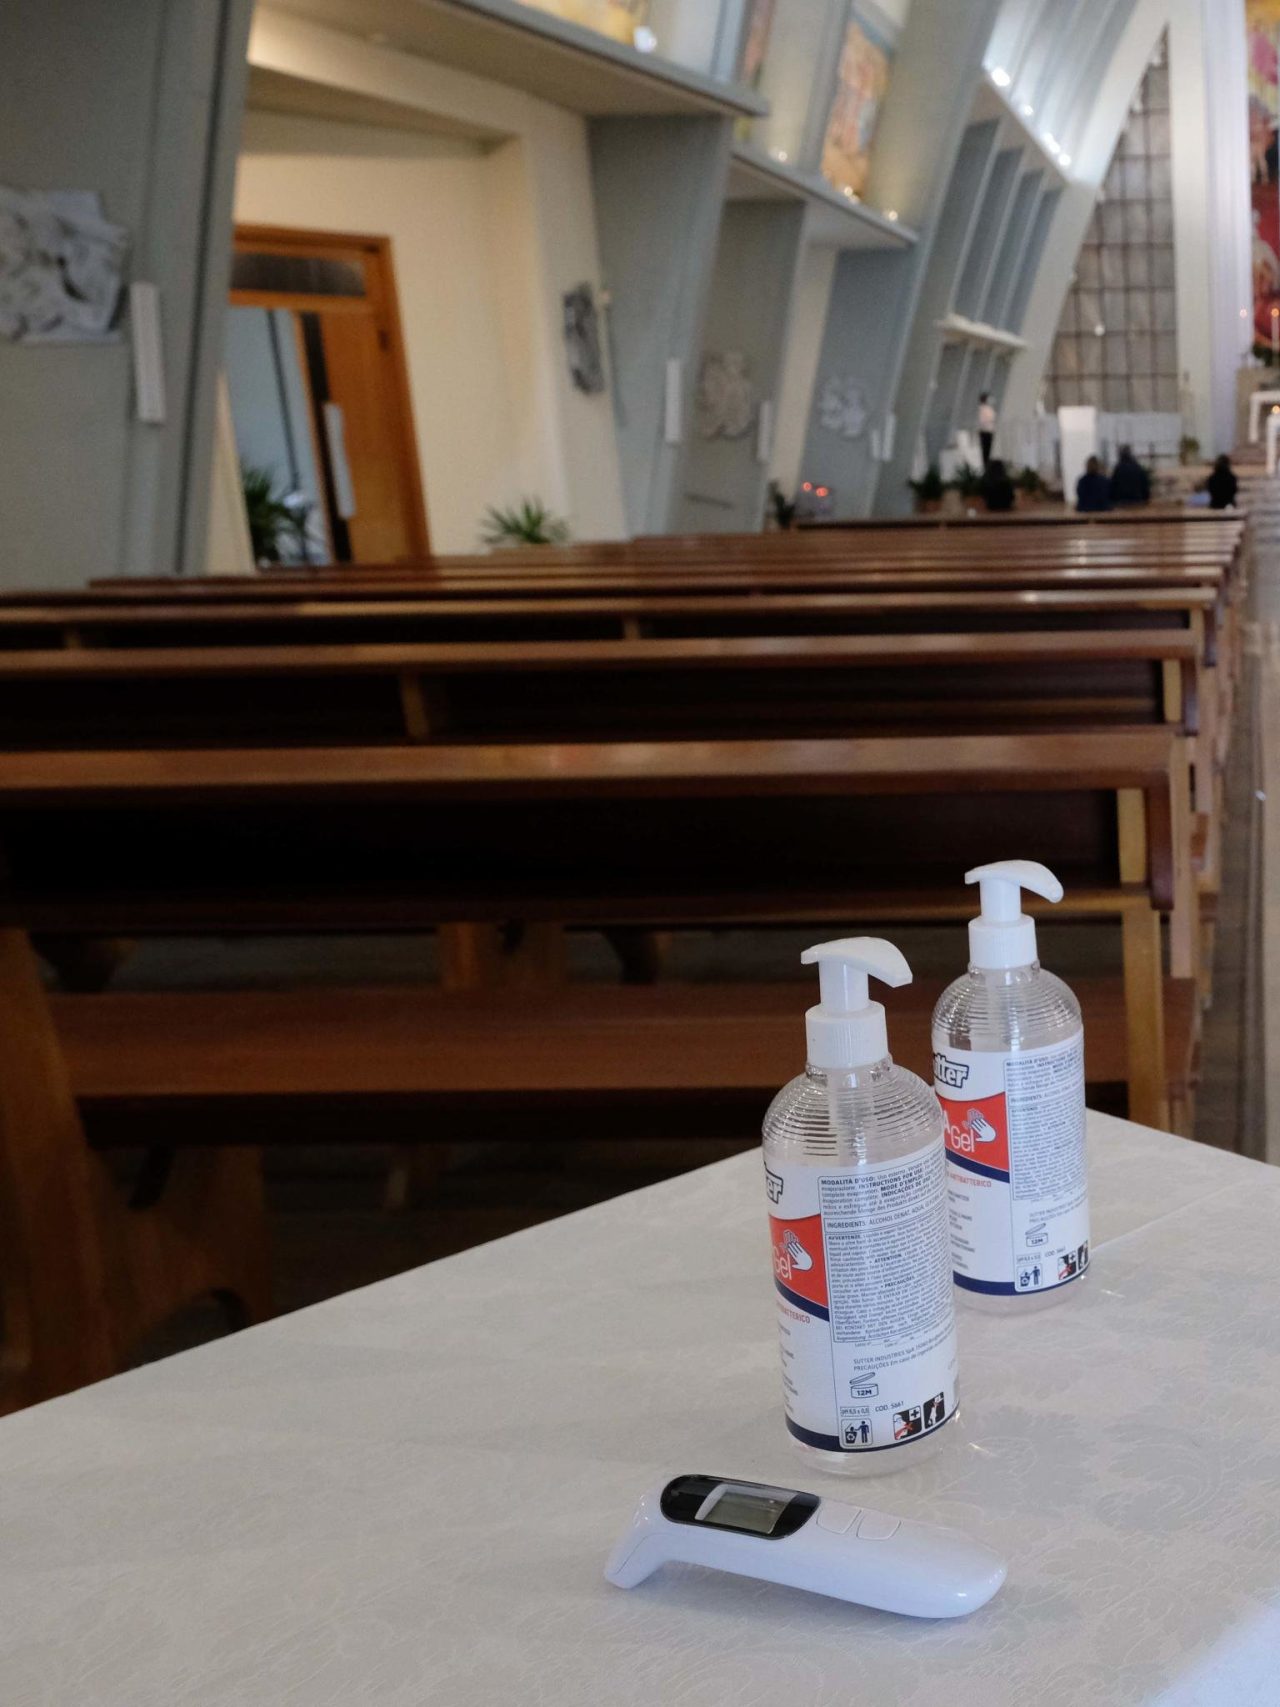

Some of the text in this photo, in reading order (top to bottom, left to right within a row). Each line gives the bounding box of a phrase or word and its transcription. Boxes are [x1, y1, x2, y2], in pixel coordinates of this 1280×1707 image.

[950, 1125, 975, 1153] Gel
[881, 1183, 899, 1192] MODE
[853, 1357, 874, 1365] SUTTER
[856, 1389, 872, 1397] 12M
